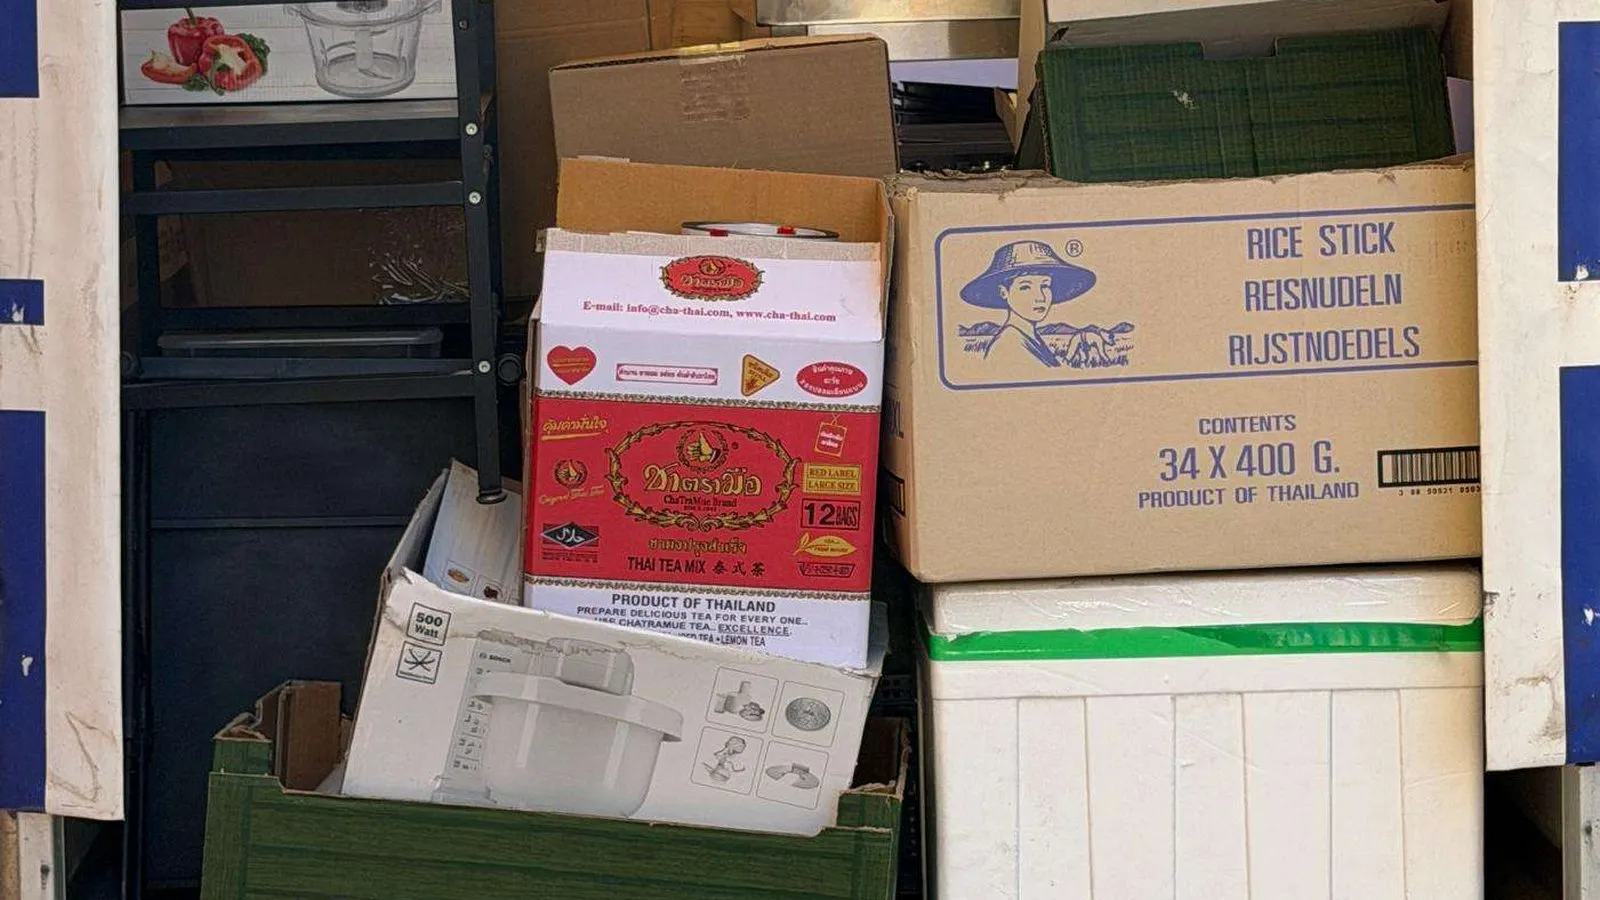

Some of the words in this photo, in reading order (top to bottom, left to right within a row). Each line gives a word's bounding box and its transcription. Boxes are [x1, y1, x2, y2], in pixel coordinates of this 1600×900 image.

[1247, 226, 1303, 260] RICE
[1319, 221, 1396, 257] STICK
[1244, 273, 1402, 312] REISNUDELN
[583, 301, 623, 312] E-mail:
[736, 310, 836, 322] www.cha-thai.com
[1228, 326, 1420, 366] RIJSTNOEDELS
[1199, 414, 1296, 435] CONTENTS
[1159, 447, 1200, 482] 34
[1208, 445, 1227, 479] X
[1236, 442, 1296, 477] 400
[1313, 440, 1340, 473] G.
[643, 462, 762, 496] ชาตรามือ
[809, 468, 827, 477] RED
[829, 468, 857, 478] LABEL
[808, 480, 836, 489] LARGE
[838, 482, 856, 491] SIZE
[1138, 488, 1226, 509] PRODUCT
[1235, 487, 1257, 504] OF
[1267, 481, 1359, 502] THAILAND
[804, 502, 836, 526] 12
[836, 505, 858, 527] BAGS
[627, 556, 656, 573] THAI
[658, 558, 682, 573] TEA
[684, 560, 706, 574] MIX
[612, 593, 679, 609] PRODUCT
[683, 597, 701, 609] OF
[705, 598, 776, 613] THAILAND
[416, 612, 443, 627] 500
[576, 606, 626, 617] PREPARE
[631, 609, 687, 620] DELICIOUS
[692, 612, 712, 621] TEA
[716, 613, 737, 622] FOR
[741, 615, 776, 624] EVERY
[618, 618, 686, 630] CHATRAMUE
[414, 624, 439, 638] Watt
[720, 635, 747, 646] LEMON
[750, 636, 766, 647] TEA
